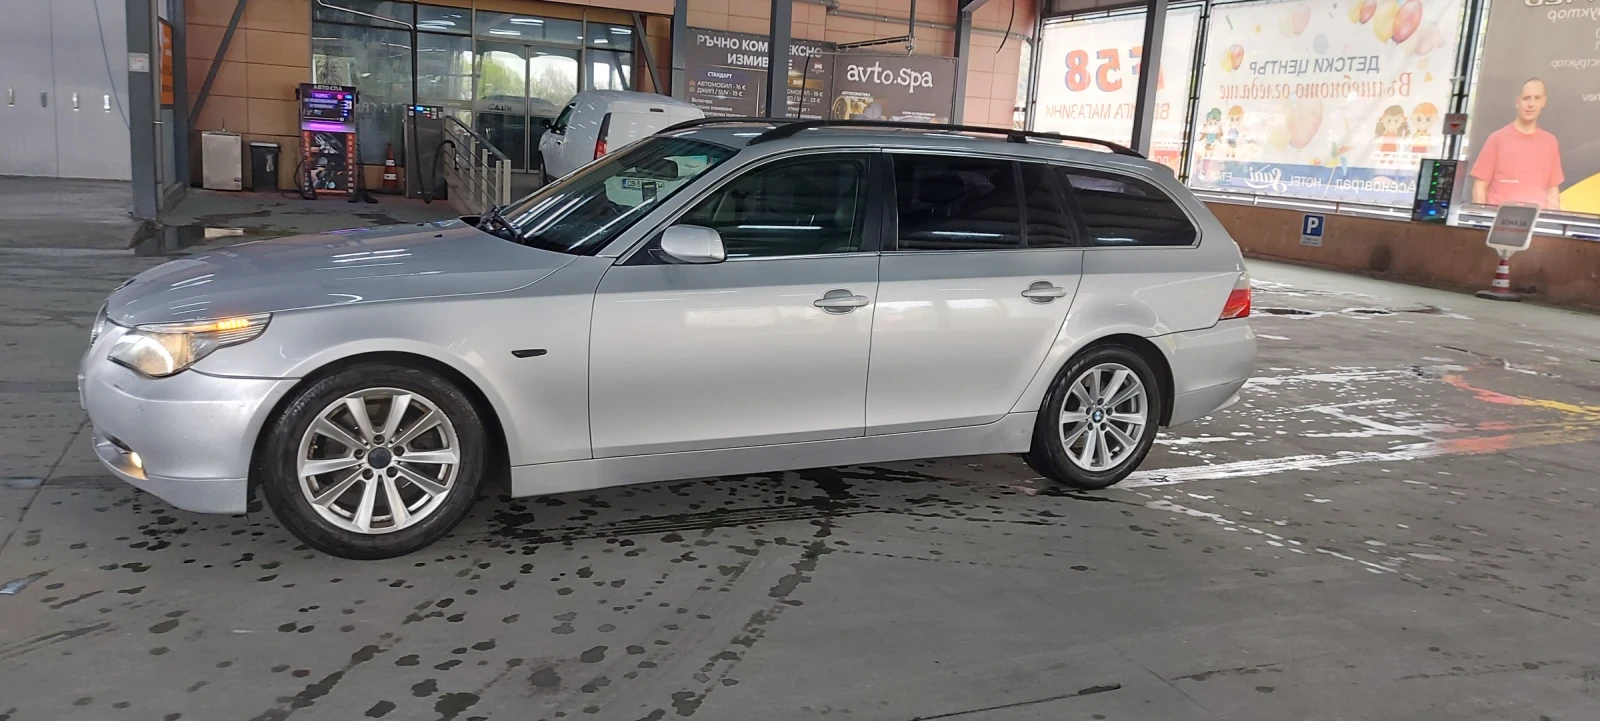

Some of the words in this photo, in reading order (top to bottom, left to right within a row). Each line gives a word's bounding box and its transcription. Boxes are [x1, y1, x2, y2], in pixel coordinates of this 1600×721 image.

[696, 34, 740, 50] РЪЧНО
[707, 71, 733, 79] СТАНДАРТ
[847, 61, 933, 93] avto.spa
[697, 80, 733, 89] АВТОМОБИЛ
[697, 87, 715, 95] ДЖИП
[1306, 216, 1320, 234] P
